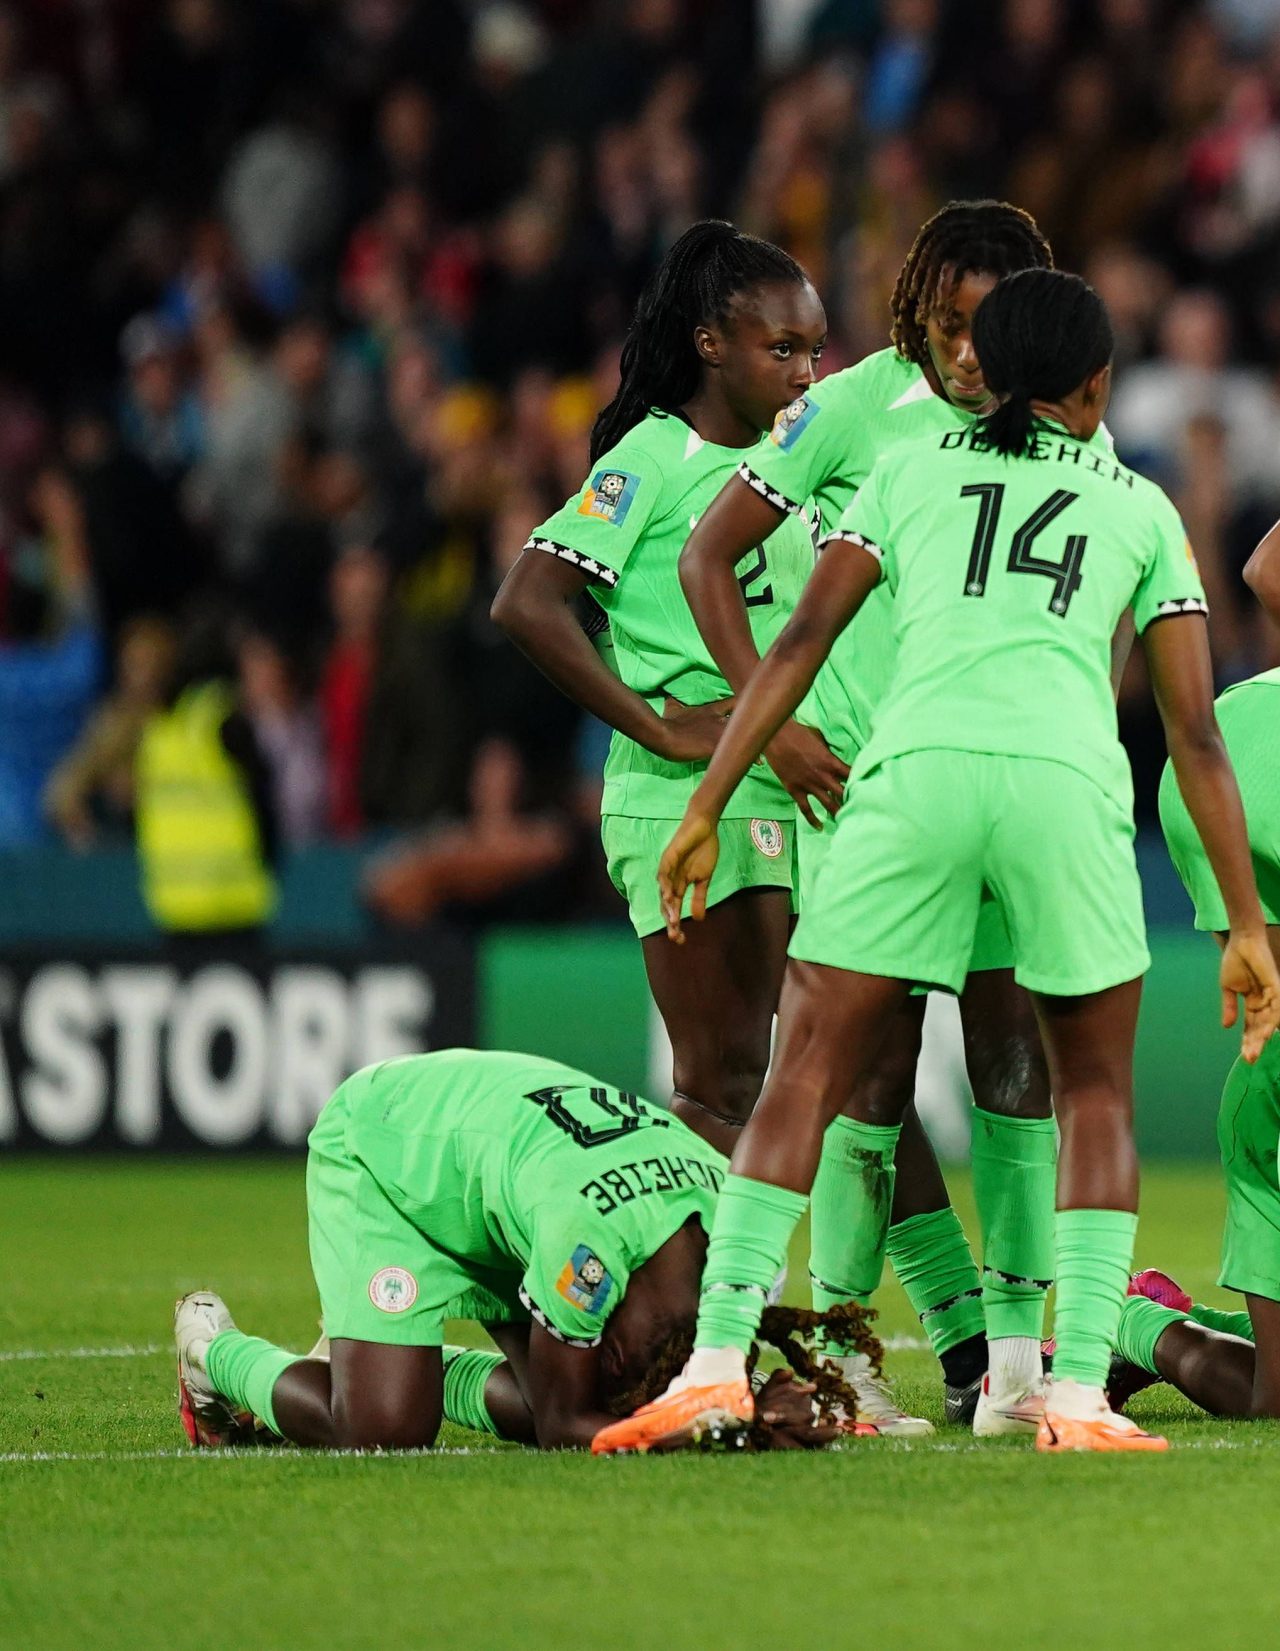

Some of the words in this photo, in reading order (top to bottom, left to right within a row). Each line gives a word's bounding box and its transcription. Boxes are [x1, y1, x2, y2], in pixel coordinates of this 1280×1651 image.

[939, 427, 1136, 489] DEEHIN
[960, 483, 1088, 618] 14
[0, 961, 434, 1147] STORE
[579, 1156, 726, 1217] UCHEIBE
